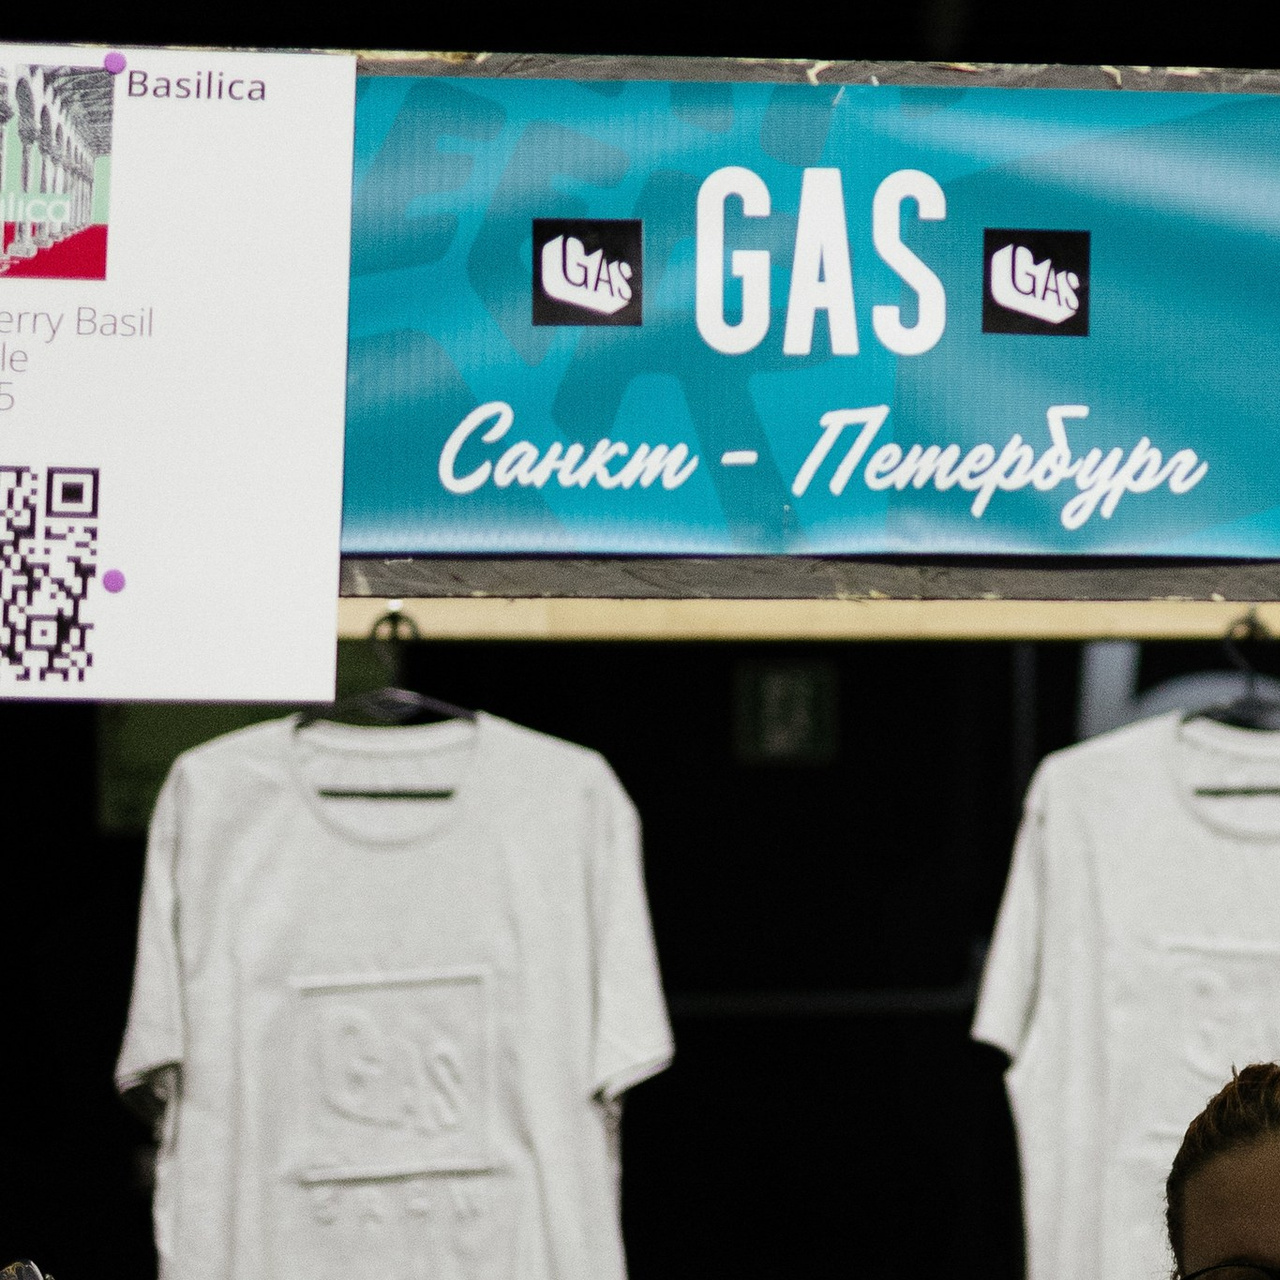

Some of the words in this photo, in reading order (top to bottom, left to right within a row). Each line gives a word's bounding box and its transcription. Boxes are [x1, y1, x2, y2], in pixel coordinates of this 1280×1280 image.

[127, 70, 267, 102] Basilica
[541, 234, 633, 315] GAS
[698, 167, 946, 354] GAS
[991, 244, 1079, 323] GAS
[76, 306, 153, 337] Basil
[438, 400, 699, 494] Санкт
[791, 404, 1209, 530] Петербург
